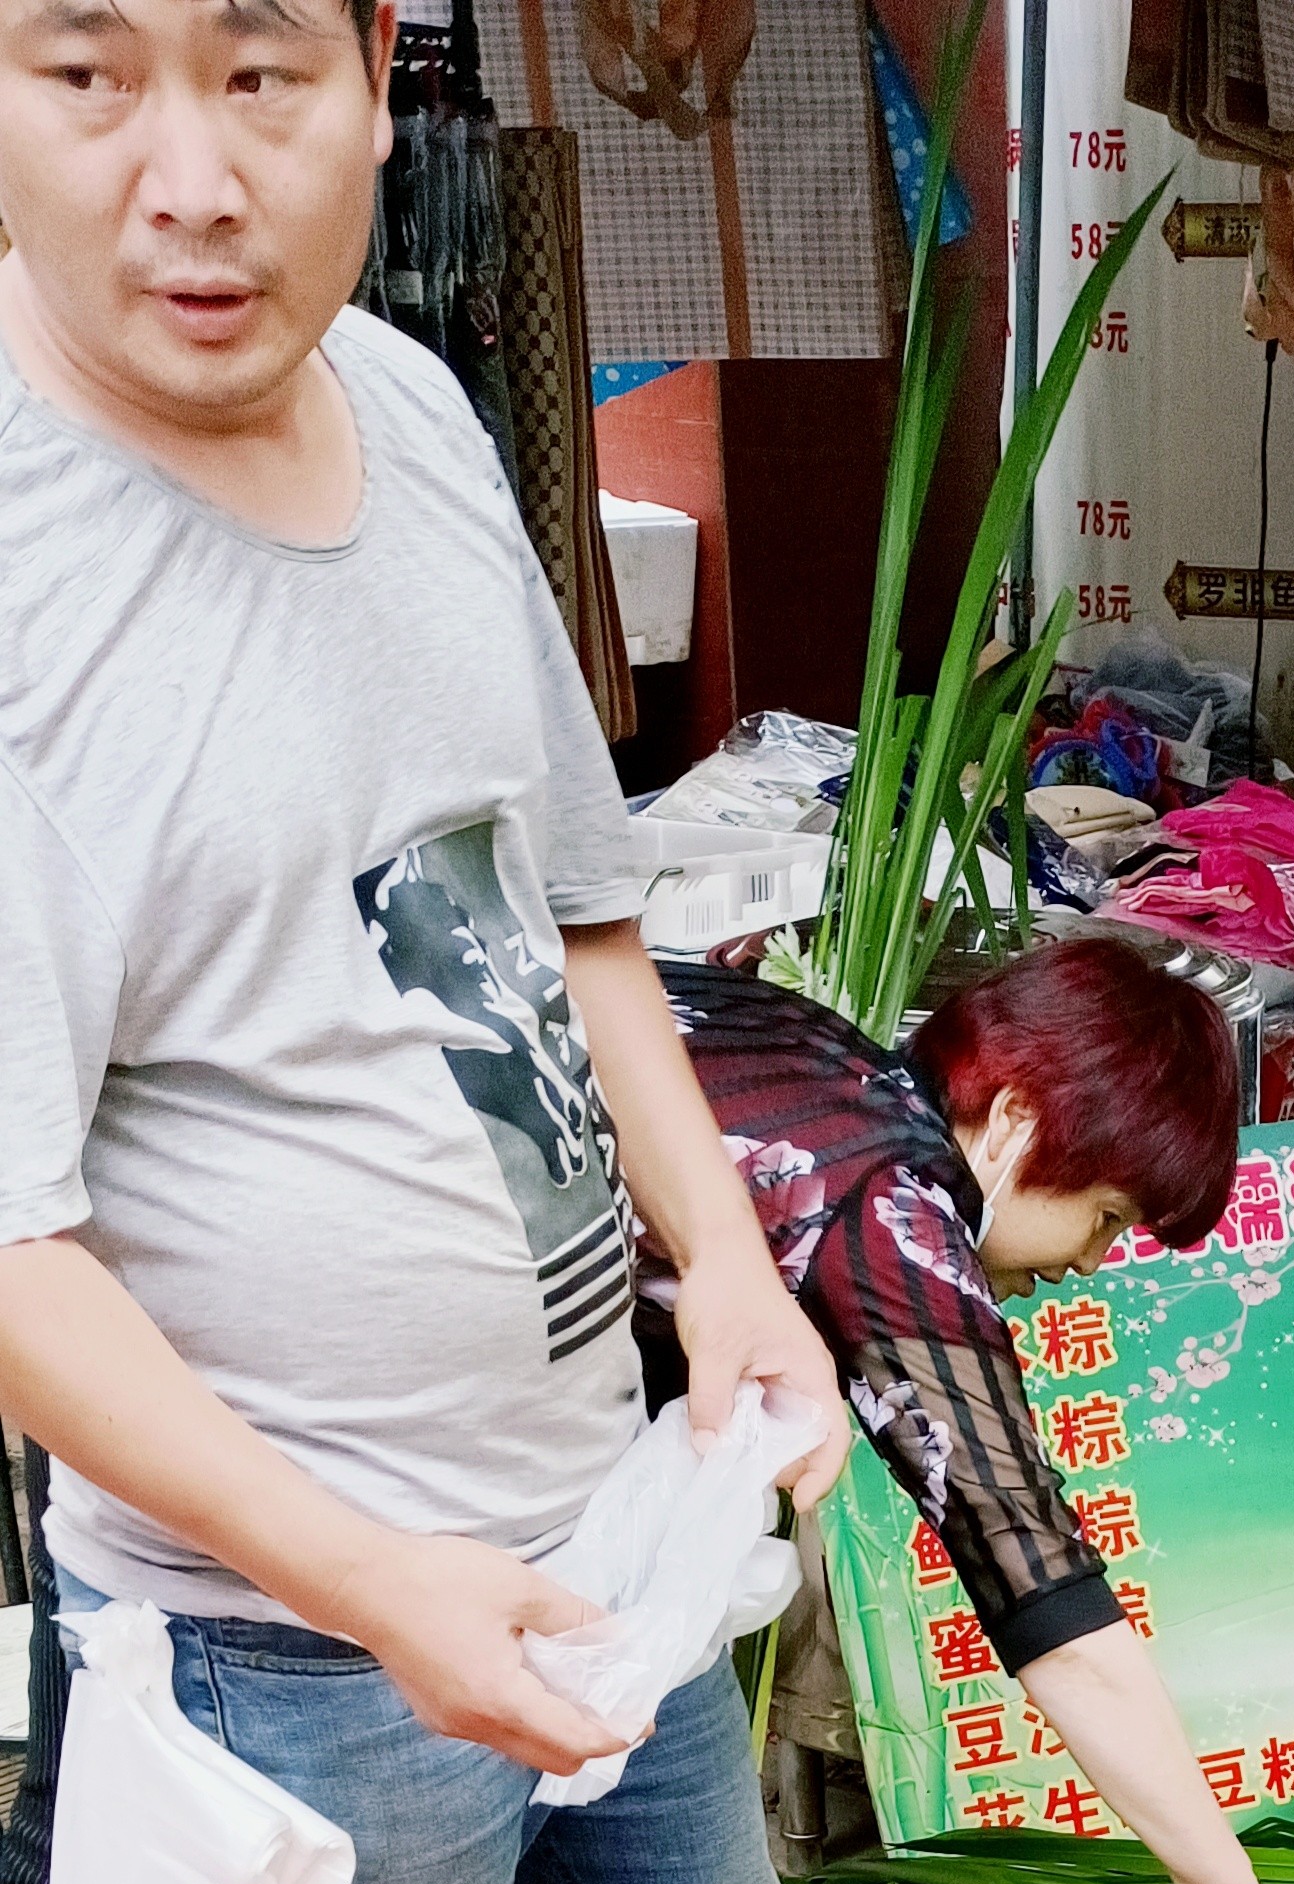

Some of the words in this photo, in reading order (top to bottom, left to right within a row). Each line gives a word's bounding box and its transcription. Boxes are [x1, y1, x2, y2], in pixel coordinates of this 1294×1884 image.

[1069, 128, 1127, 173] 78元
[1076, 500, 1132, 541] 78元
[1077, 584, 1133, 624] 58元
[1029, 1396, 1126, 1469] 粽
